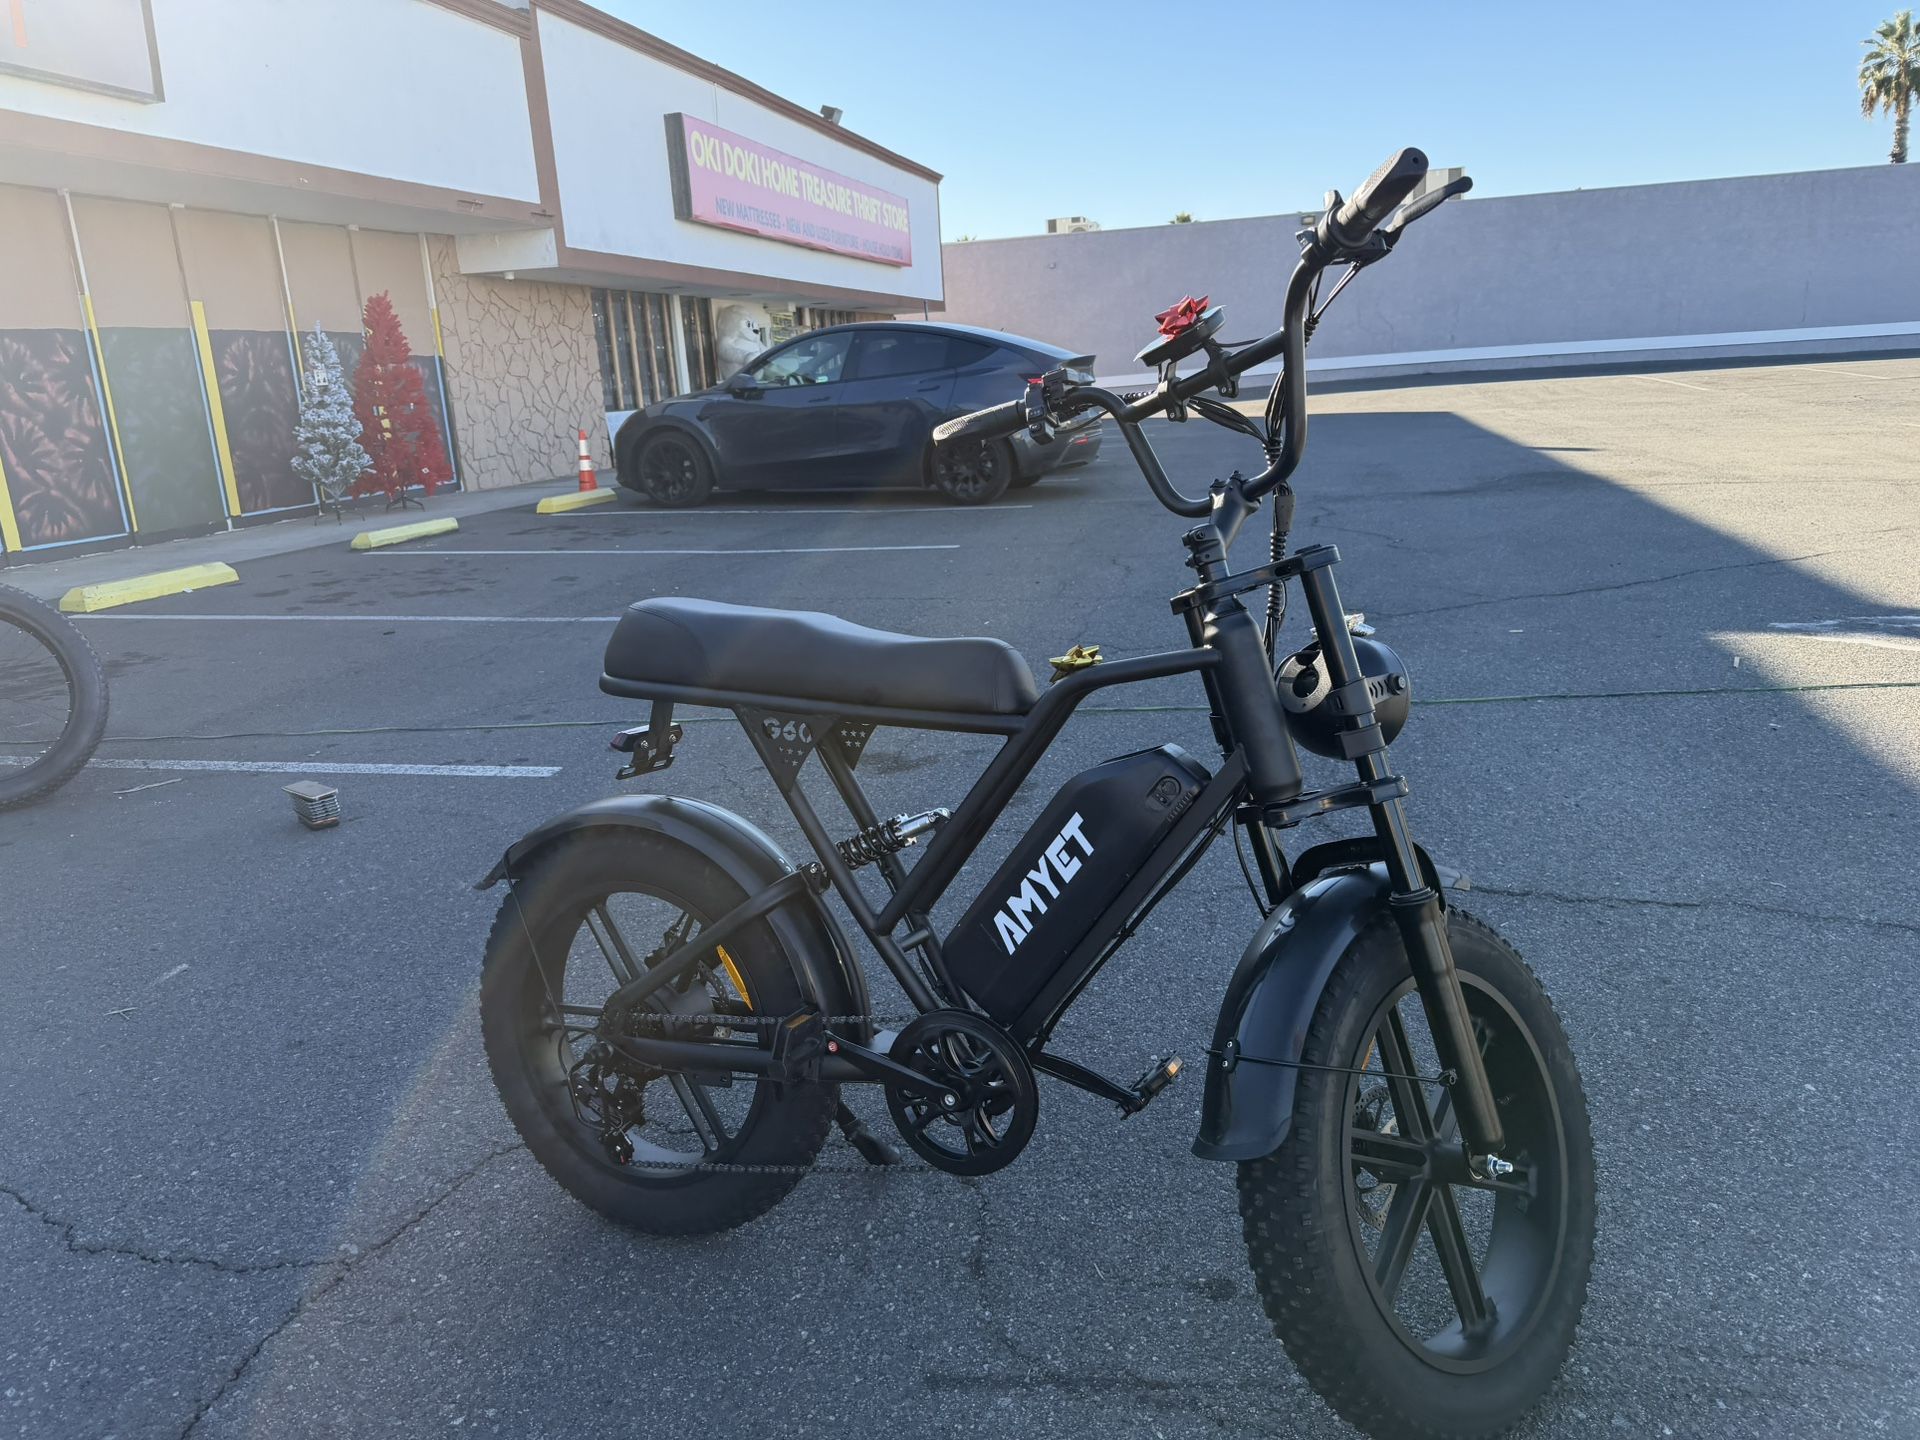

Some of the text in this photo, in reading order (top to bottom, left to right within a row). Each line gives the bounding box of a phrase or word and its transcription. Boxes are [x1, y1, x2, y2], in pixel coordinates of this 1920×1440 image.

[691, 130, 908, 233] OKI DOKI HOME TREASURE THRIFT STORE
[715, 196, 735, 217] NEW
[736, 202, 781, 229] MATTRESSES
[993, 811, 1095, 956] AMYET
